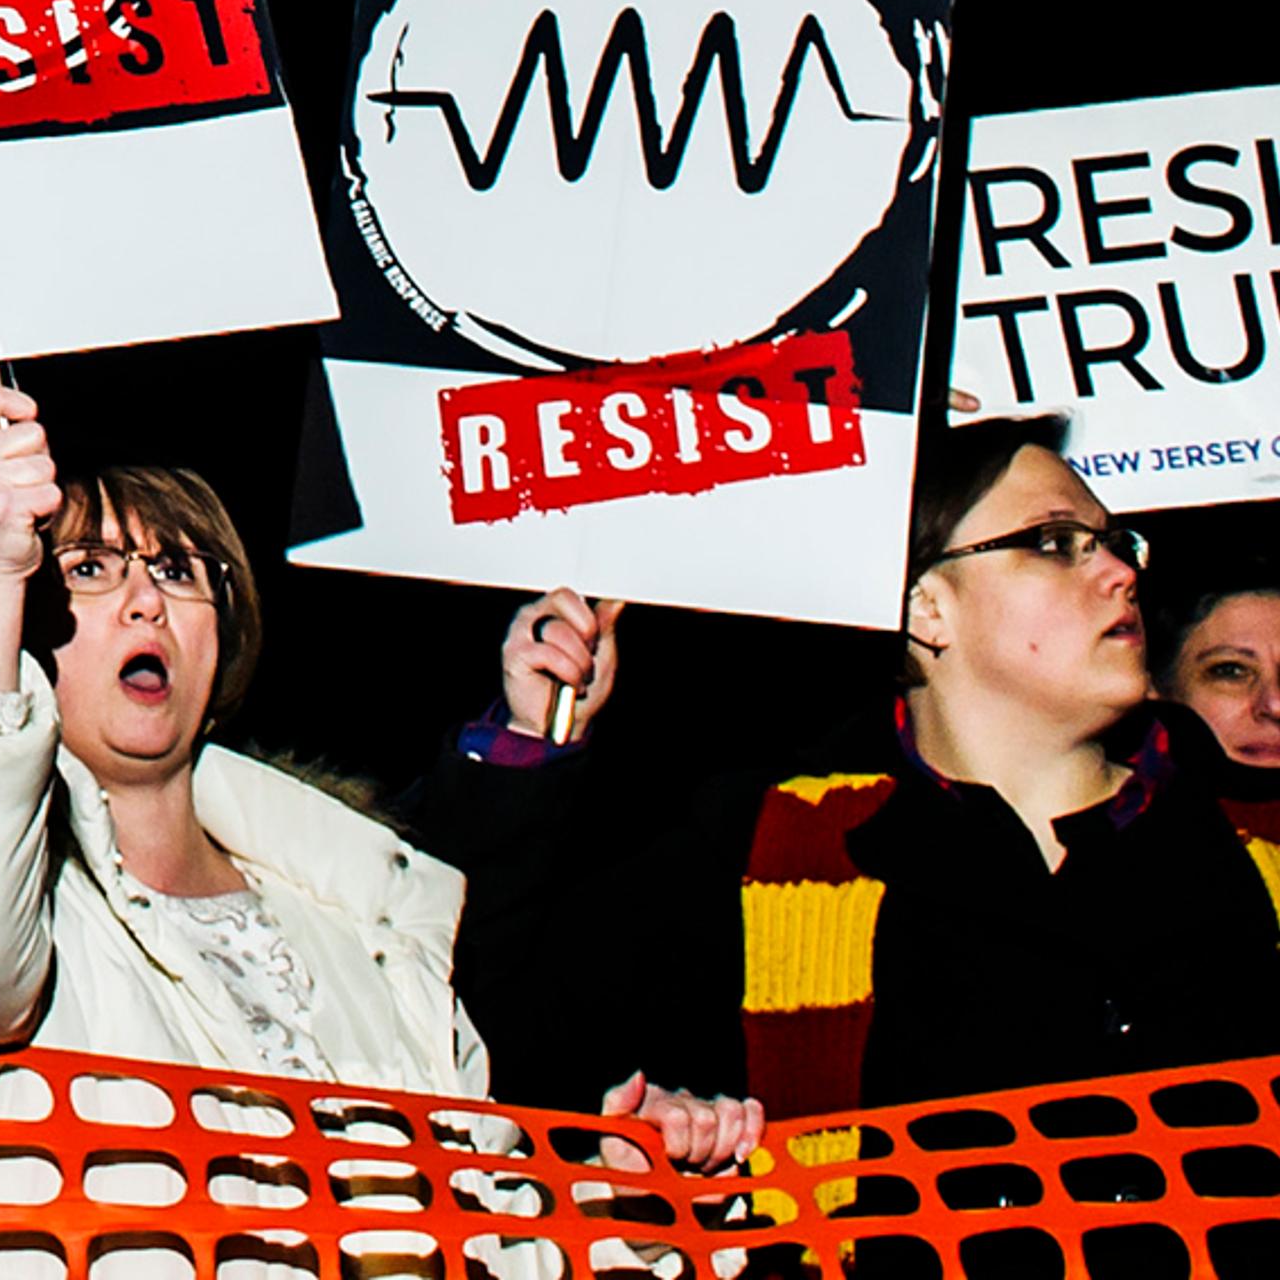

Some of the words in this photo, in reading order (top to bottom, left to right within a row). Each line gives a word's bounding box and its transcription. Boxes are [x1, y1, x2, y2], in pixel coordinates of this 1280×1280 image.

[962, 270, 1280, 405] TRU
[457, 365, 837, 494] RESIST
[1066, 450, 1140, 477] NEW
[1149, 439, 1261, 472] JERSEY
